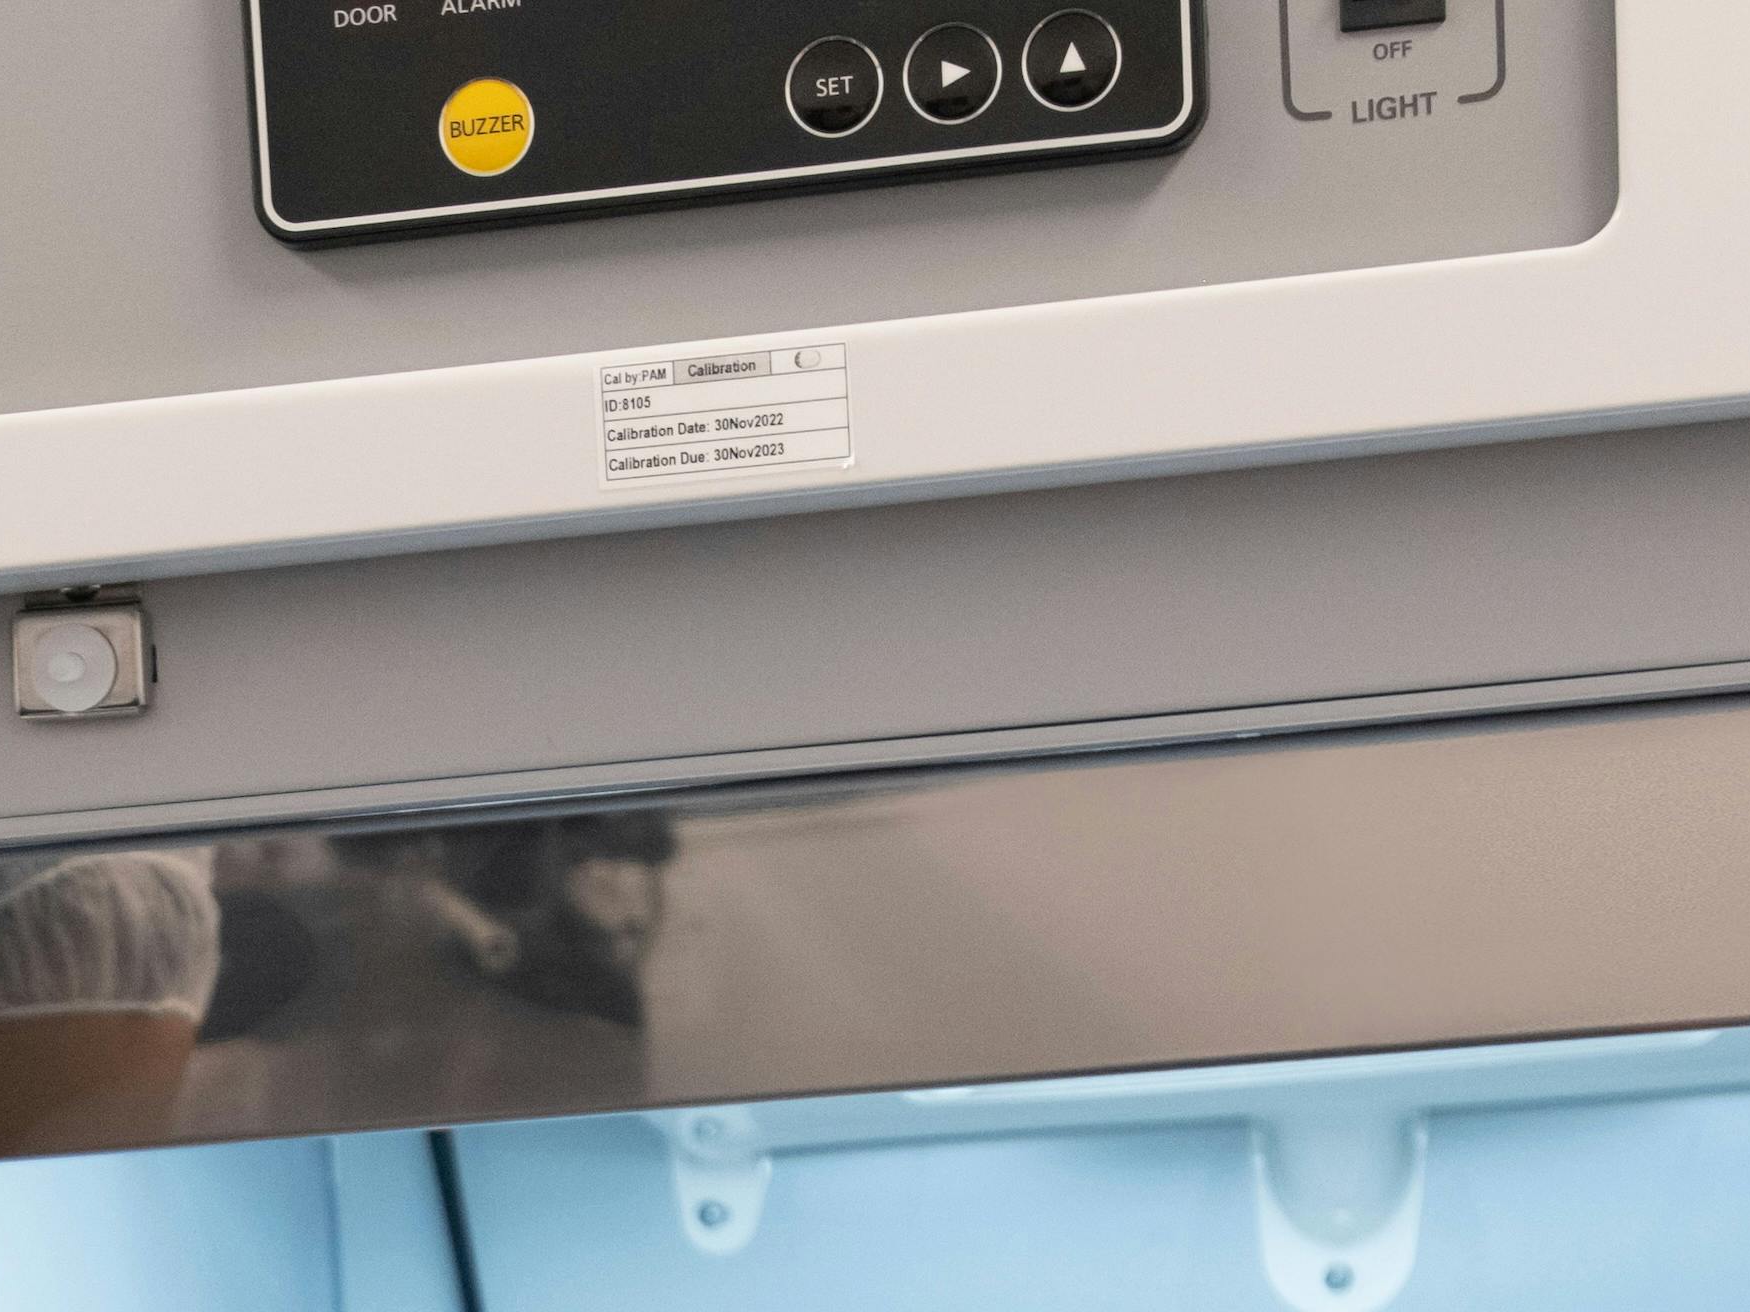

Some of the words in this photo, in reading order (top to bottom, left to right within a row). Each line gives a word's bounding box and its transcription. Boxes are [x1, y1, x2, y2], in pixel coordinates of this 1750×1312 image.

[333, 4, 397, 28] DOOR
[1372, 40, 1413, 60] OFF
[815, 75, 854, 97] SET
[1351, 91, 1438, 124] LIGHT
[450, 114, 525, 138] BUZZER
[604, 371, 622, 386] Cal
[625, 367, 667, 386] by:PAM
[687, 358, 757, 378] Calibration
[604, 395, 651, 413] ID:8105
[607, 424, 674, 442] Calibration
[677, 421, 710, 436] Date:
[714, 412, 784, 432] 30Nov2022
[608, 453, 676, 472] Calibration
[680, 451, 709, 465] Due:
[713, 442, 785, 462] 30Nov2023
